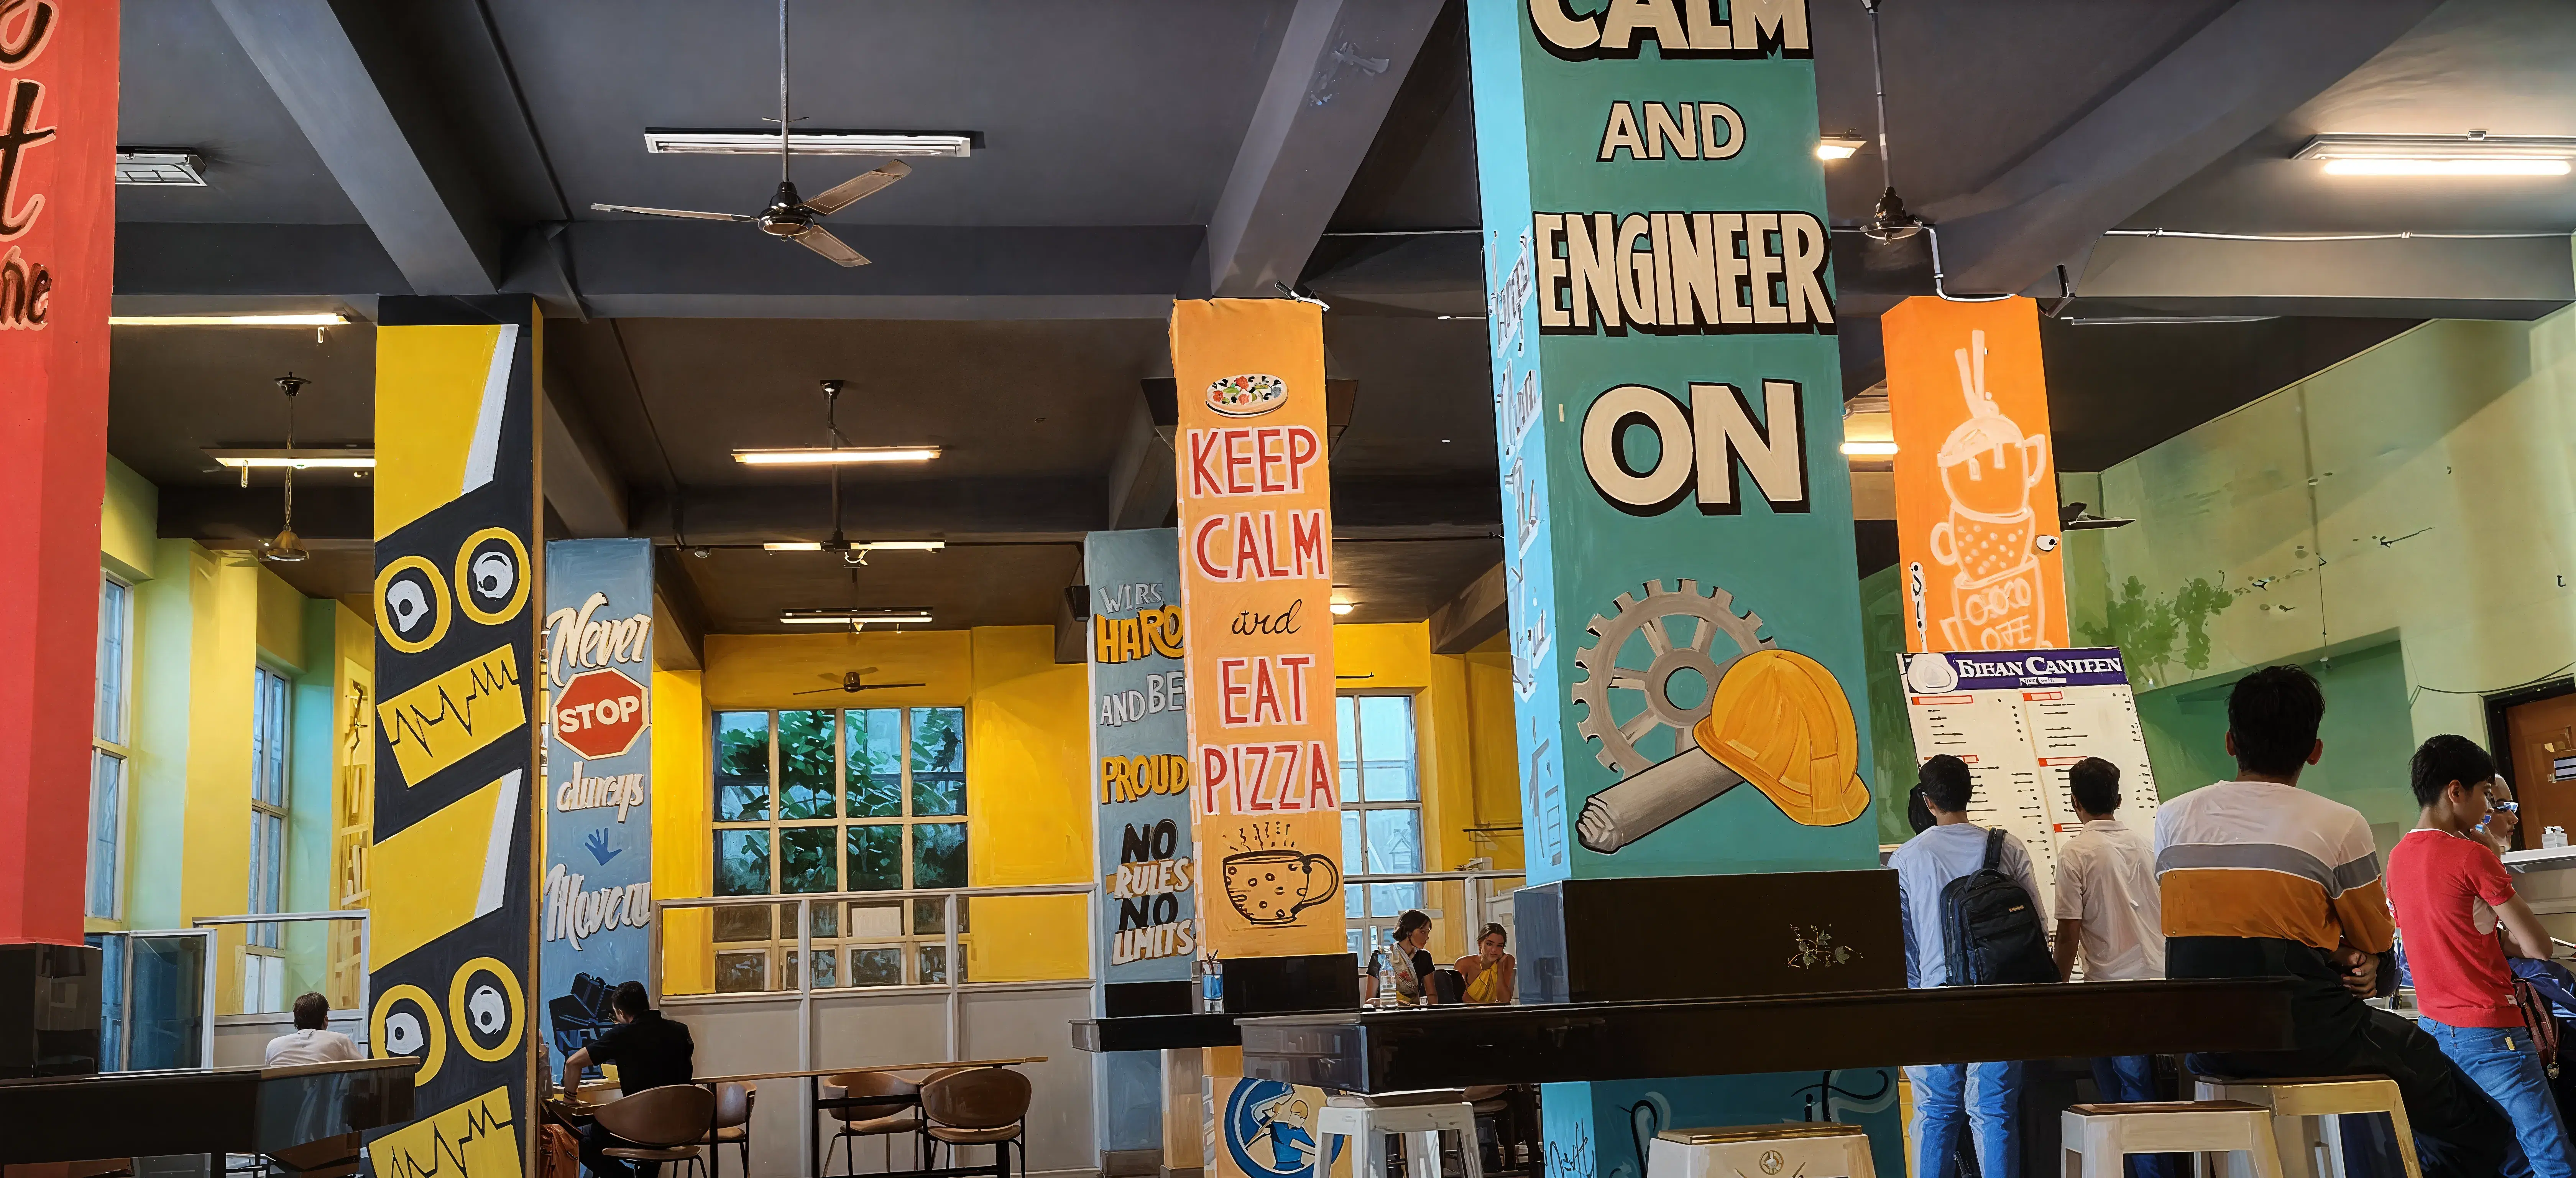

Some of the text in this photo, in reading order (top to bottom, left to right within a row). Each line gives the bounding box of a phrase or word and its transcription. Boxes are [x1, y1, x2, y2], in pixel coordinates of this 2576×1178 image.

[1530, 0, 1814, 61] CALM
[1597, 100, 1746, 162] AND
[1533, 211, 1838, 337] ENGINEER
[1187, 426, 1322, 499] KEEP
[1580, 378, 1810, 517] ON
[1191, 509, 1329, 582] CALM
[559, 695, 640, 733] STOP
[1100, 671, 1185, 727] AND BE
[1217, 653, 1315, 729] EAT
[1101, 754, 1189, 805] PROUD
[1198, 740, 1340, 816] PIZZA
[1120, 818, 1178, 865] NO
[1113, 856, 1192, 899] RULES
[1117, 892, 1178, 931] NO
